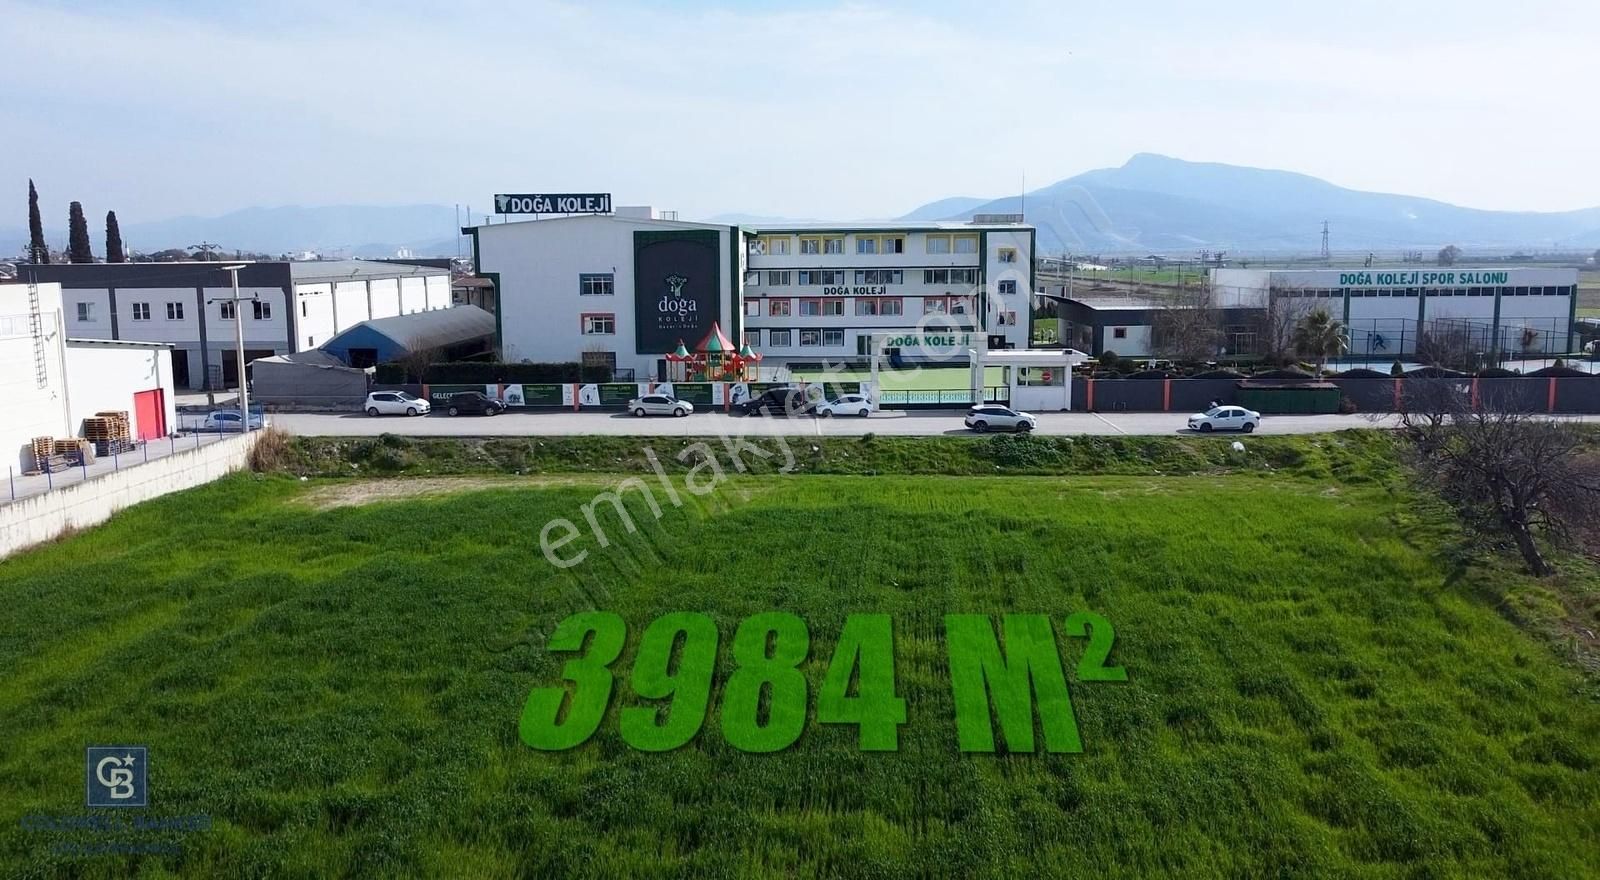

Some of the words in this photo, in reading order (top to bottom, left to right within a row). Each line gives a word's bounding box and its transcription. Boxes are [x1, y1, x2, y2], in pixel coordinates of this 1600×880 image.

[511, 195, 553, 213] DOĞA
[557, 194, 609, 212] KOLEJİ
[1340, 271, 1372, 285] DOĞA
[1376, 270, 1418, 285] KOLEJİ
[1422, 272, 1455, 285] SPOR
[1459, 271, 1508, 284] SALONU
[823, 286, 850, 295] DOĞA
[853, 285, 887, 295] KOLEJİ
[887, 335, 920, 346] DOĞA
